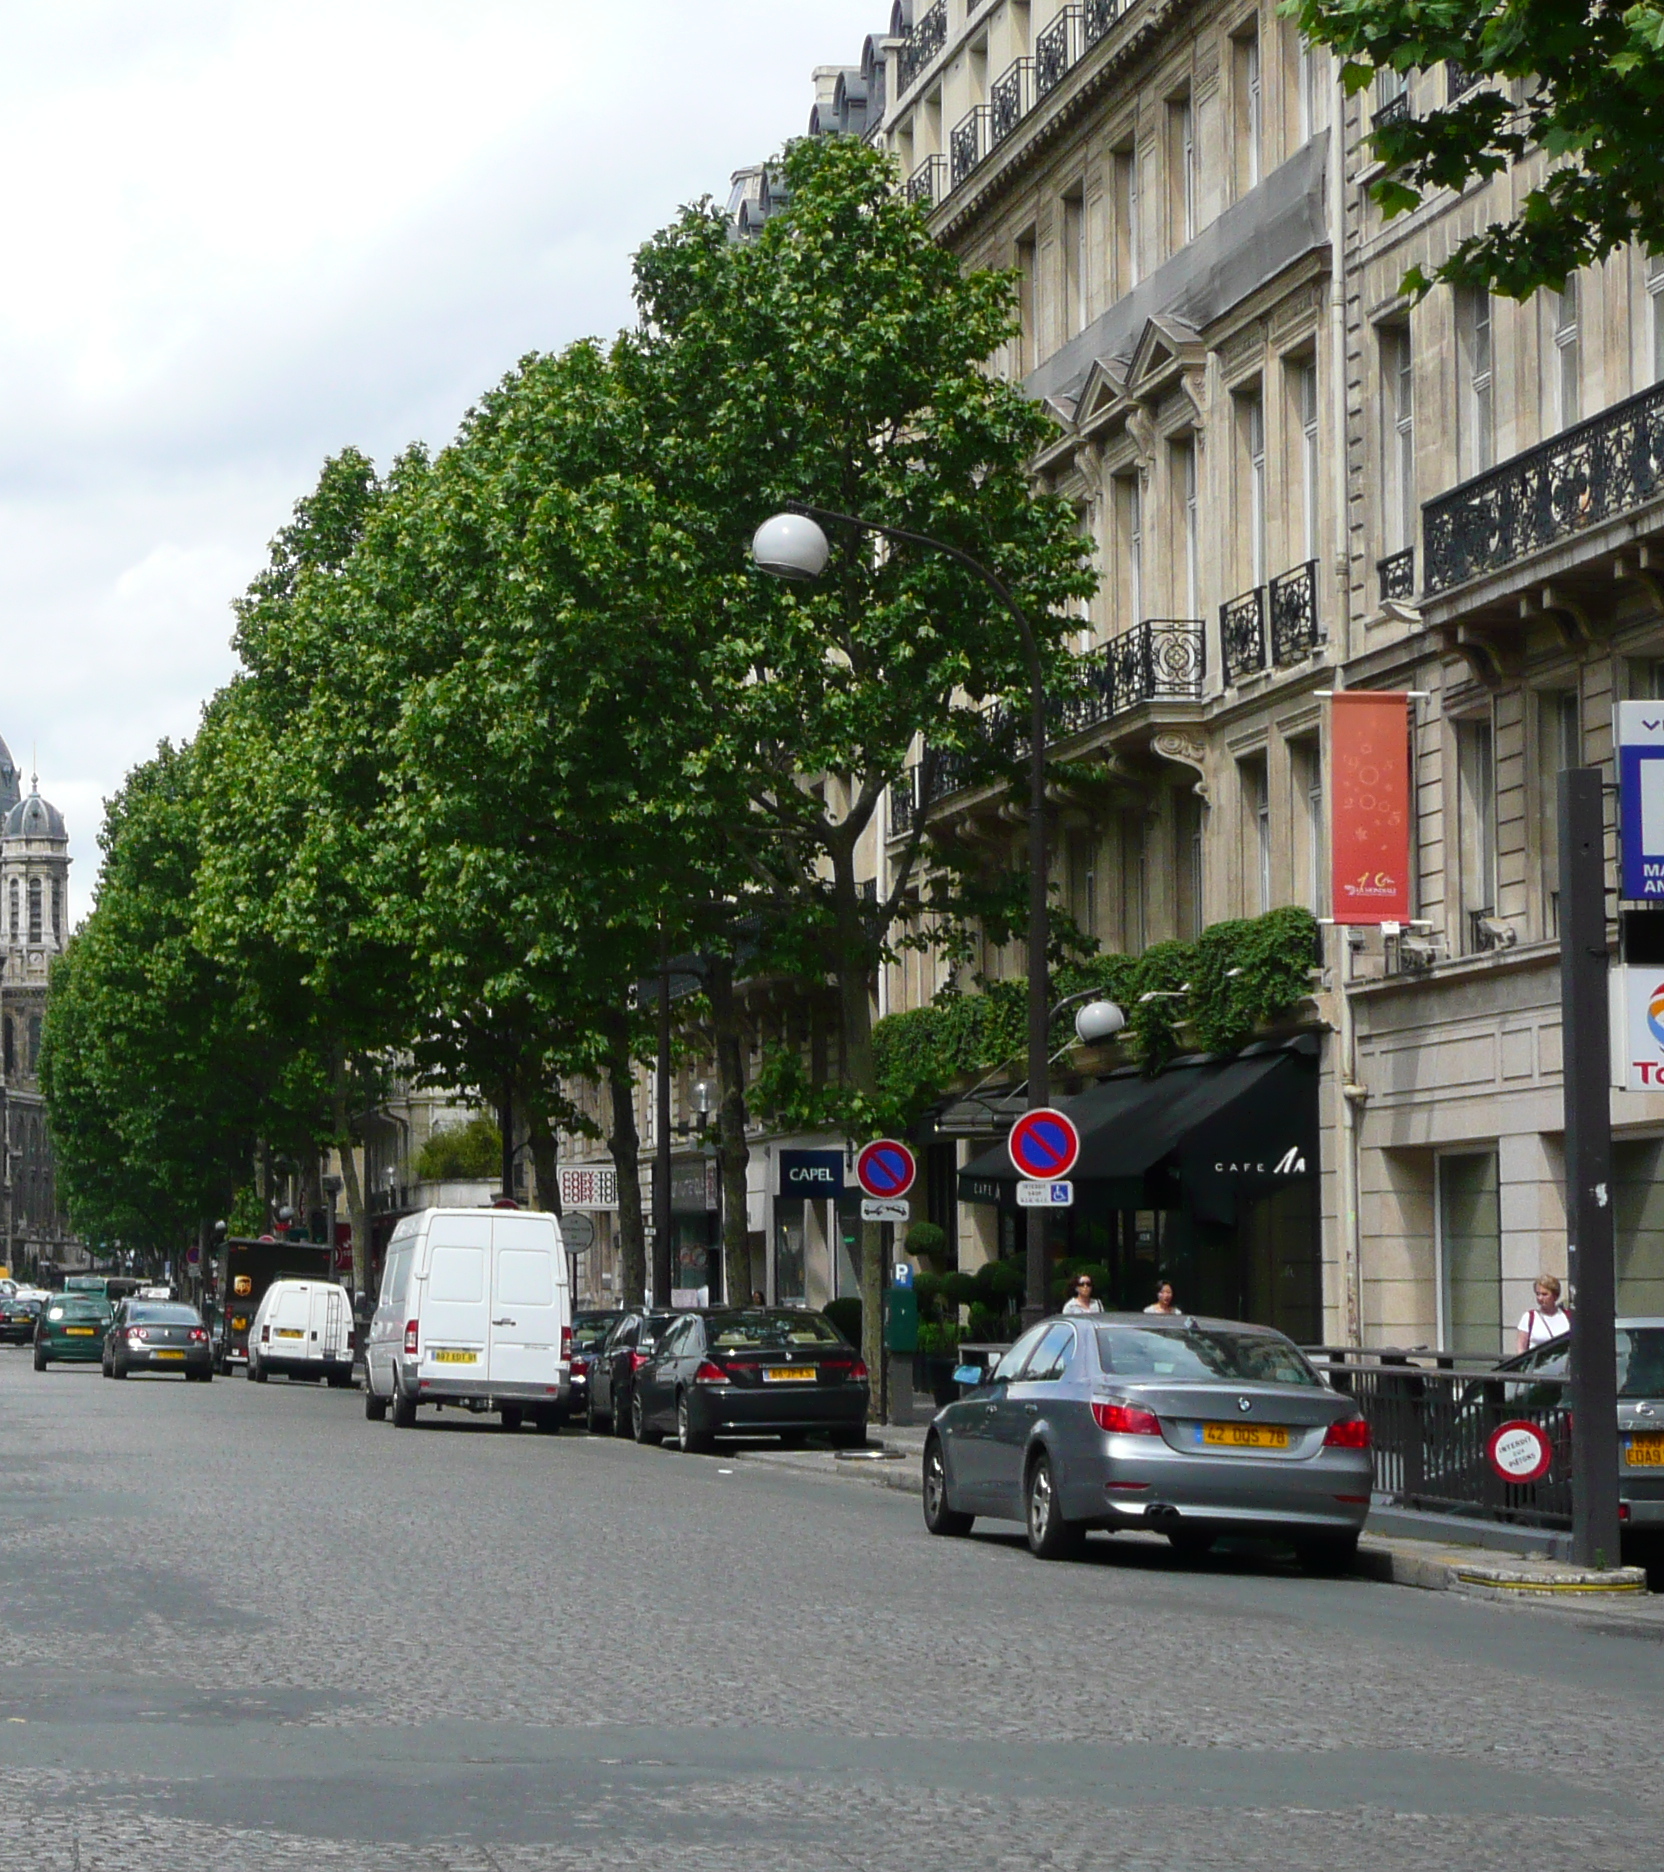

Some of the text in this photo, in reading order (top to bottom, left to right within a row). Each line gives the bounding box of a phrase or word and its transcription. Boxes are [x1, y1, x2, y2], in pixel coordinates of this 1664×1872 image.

[1215, 1163, 1265, 1172] CAFE
[790, 1168, 835, 1181] CAPEL
[895, 1263, 909, 1280] P
